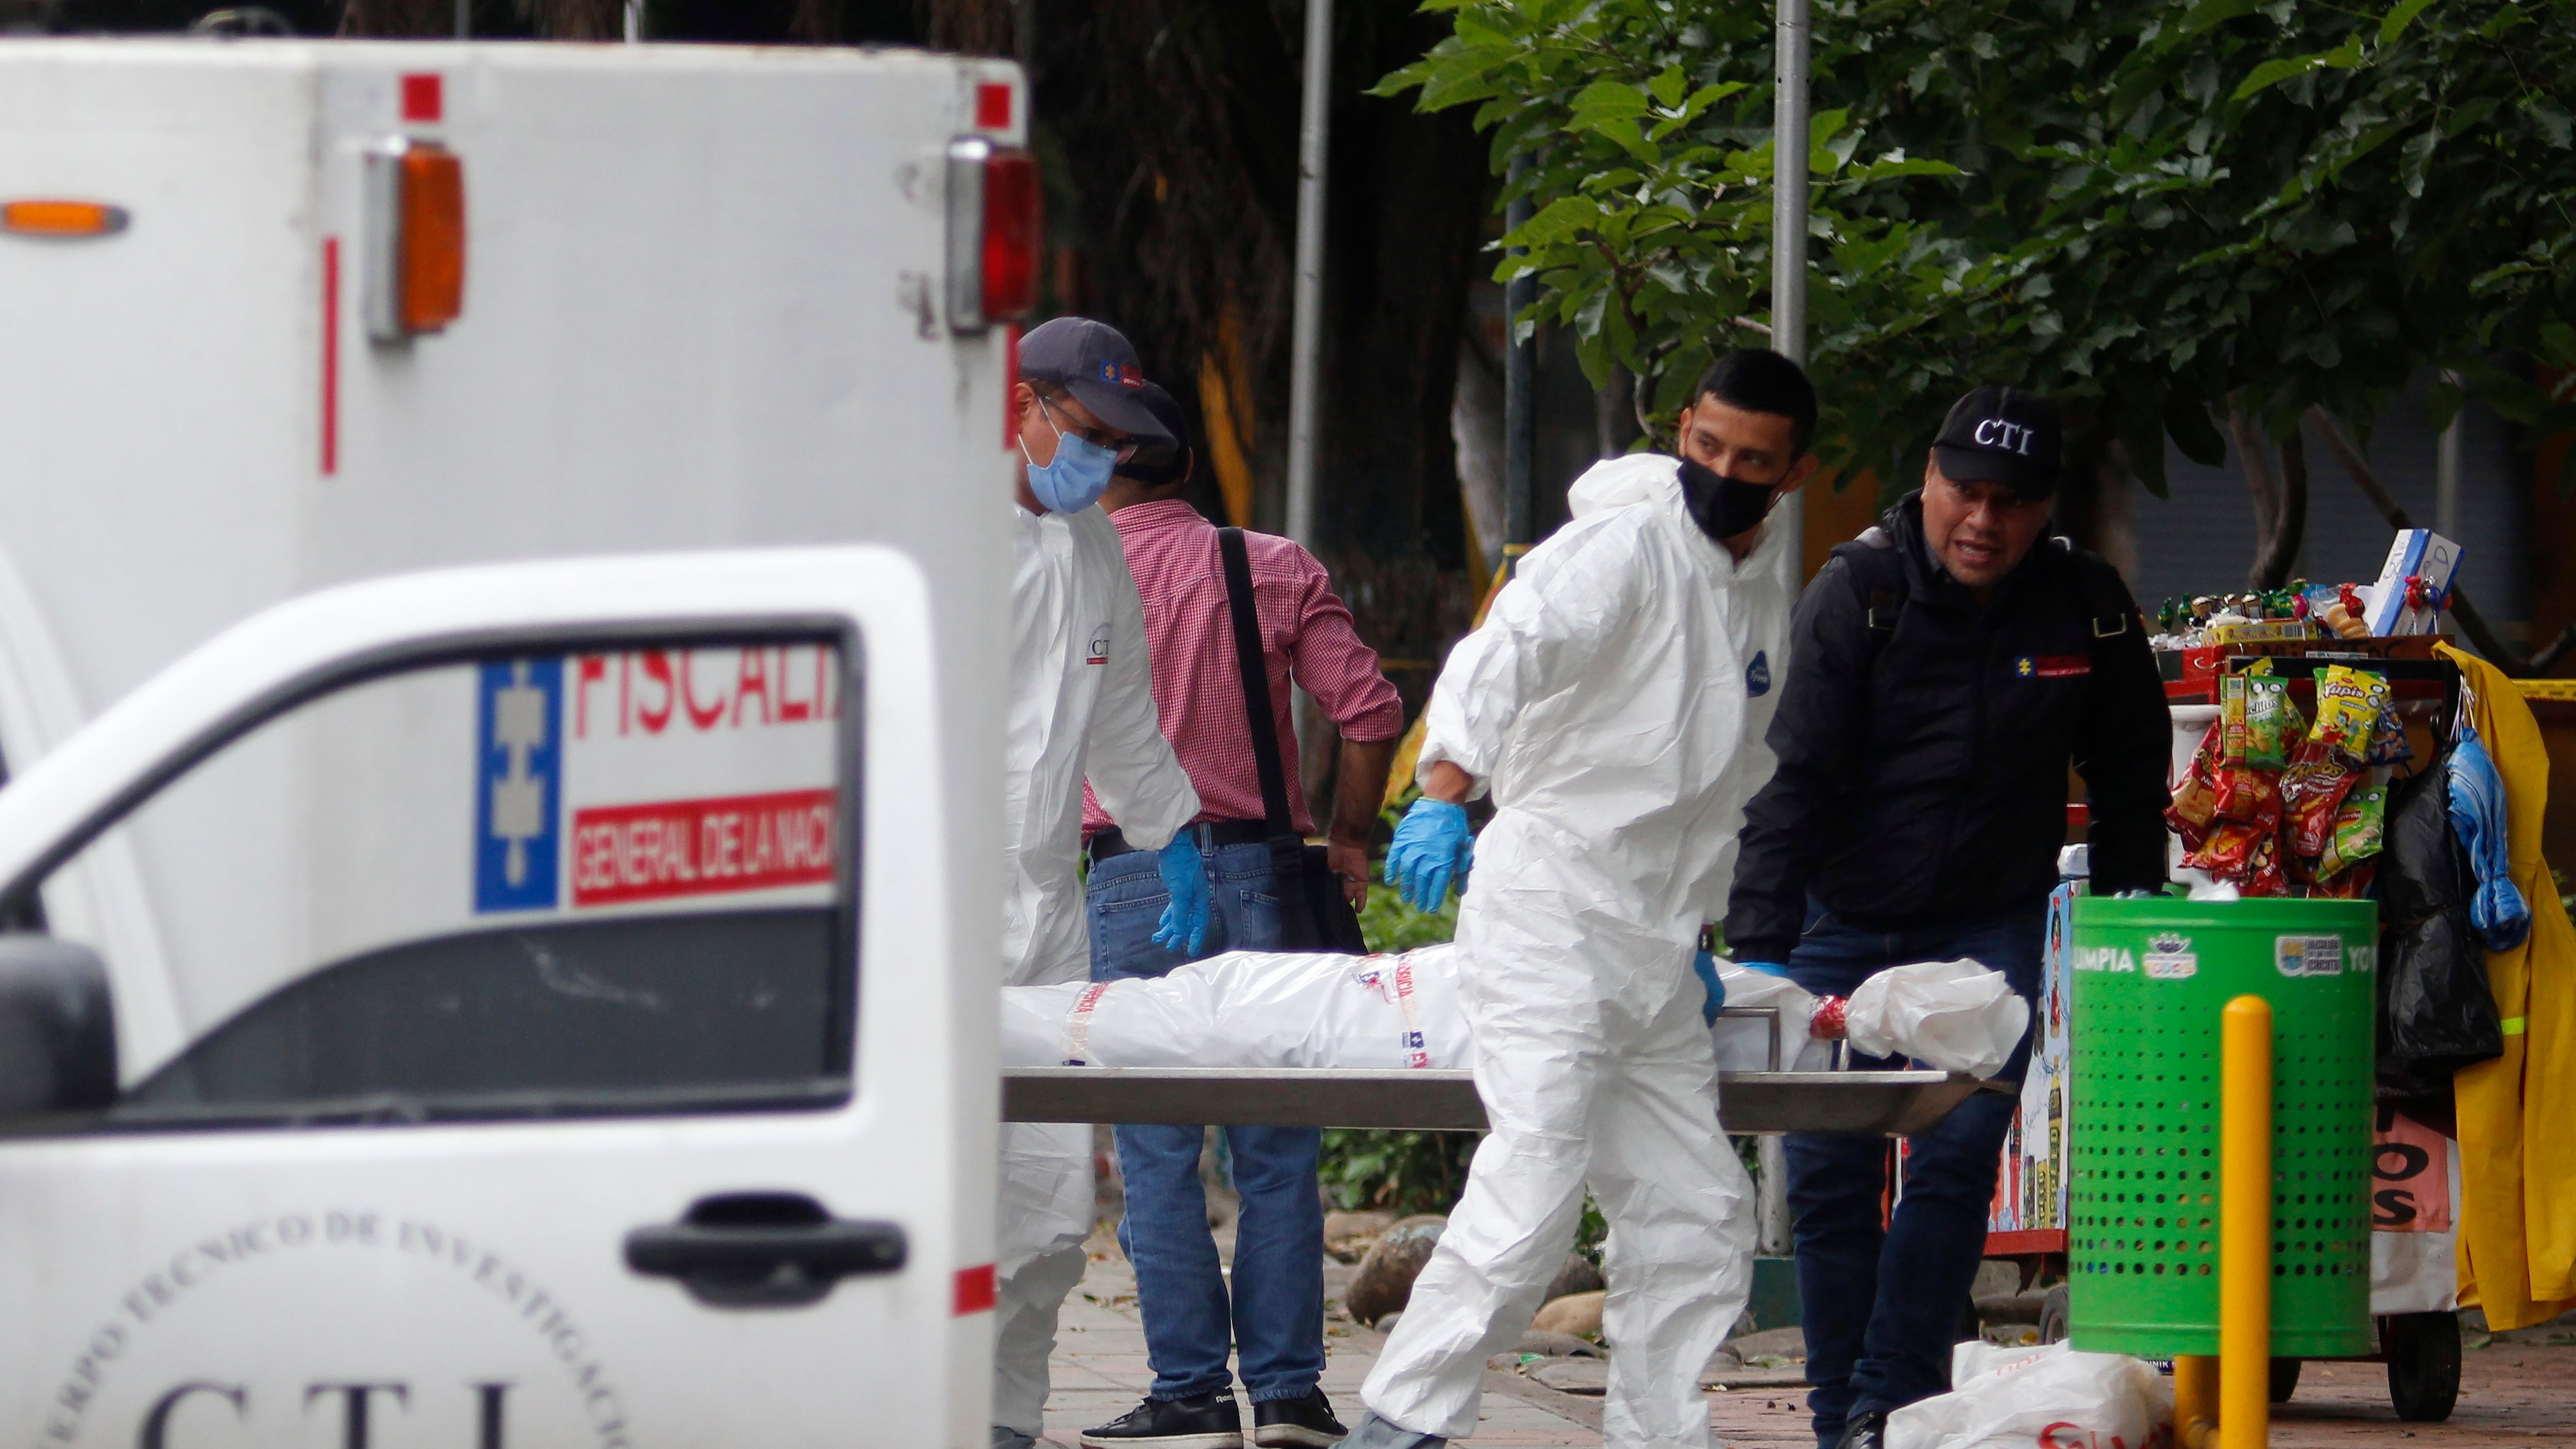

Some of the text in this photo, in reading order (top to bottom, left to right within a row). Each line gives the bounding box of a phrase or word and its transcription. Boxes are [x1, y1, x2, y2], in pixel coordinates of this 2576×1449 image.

[1974, 418, 2033, 456] CTI
[574, 647, 840, 739] FISCALI
[2325, 680, 2365, 698] Yupis
[578, 821, 695, 889] GENERAL
[701, 813, 741, 878] DE
[742, 812, 773, 875] LA
[34, 1324, 129, 1449] ERPO
[325, 1212, 380, 1243] DE
[396, 1219, 633, 1449] INVESTIGACI
[135, 1379, 519, 1449] CTI
